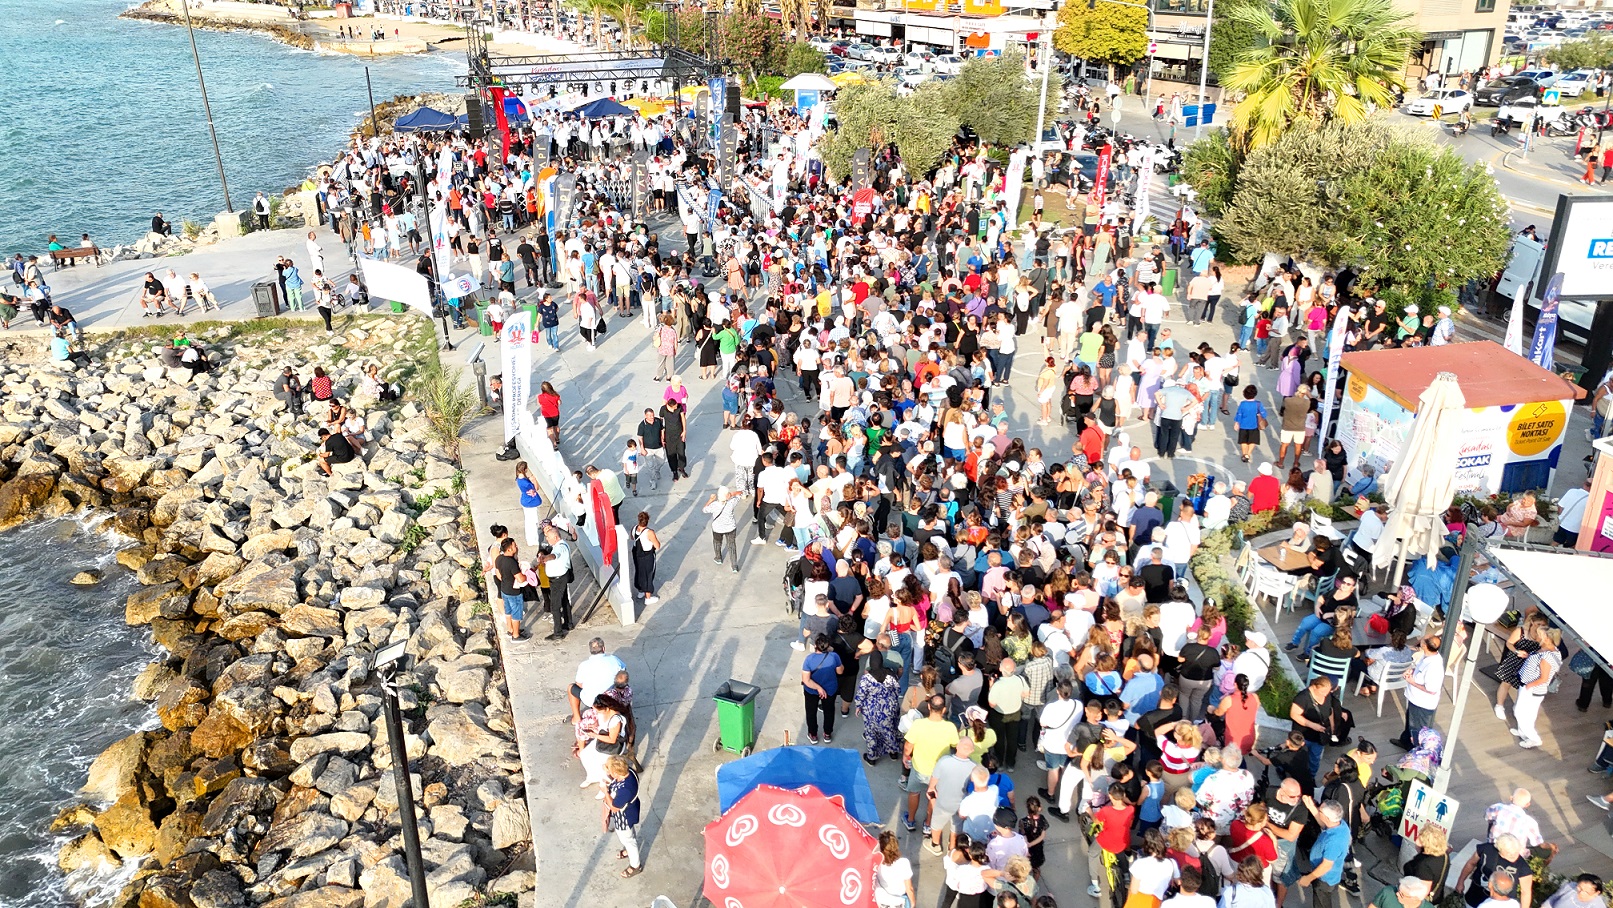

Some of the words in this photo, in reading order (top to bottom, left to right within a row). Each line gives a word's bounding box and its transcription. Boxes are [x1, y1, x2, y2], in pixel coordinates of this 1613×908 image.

[1517, 421, 1536, 431] BİLET
[1536, 420, 1555, 429] SATIŞ
[1520, 428, 1549, 438] NOKTASI
[1405, 809, 1419, 821] BAY
